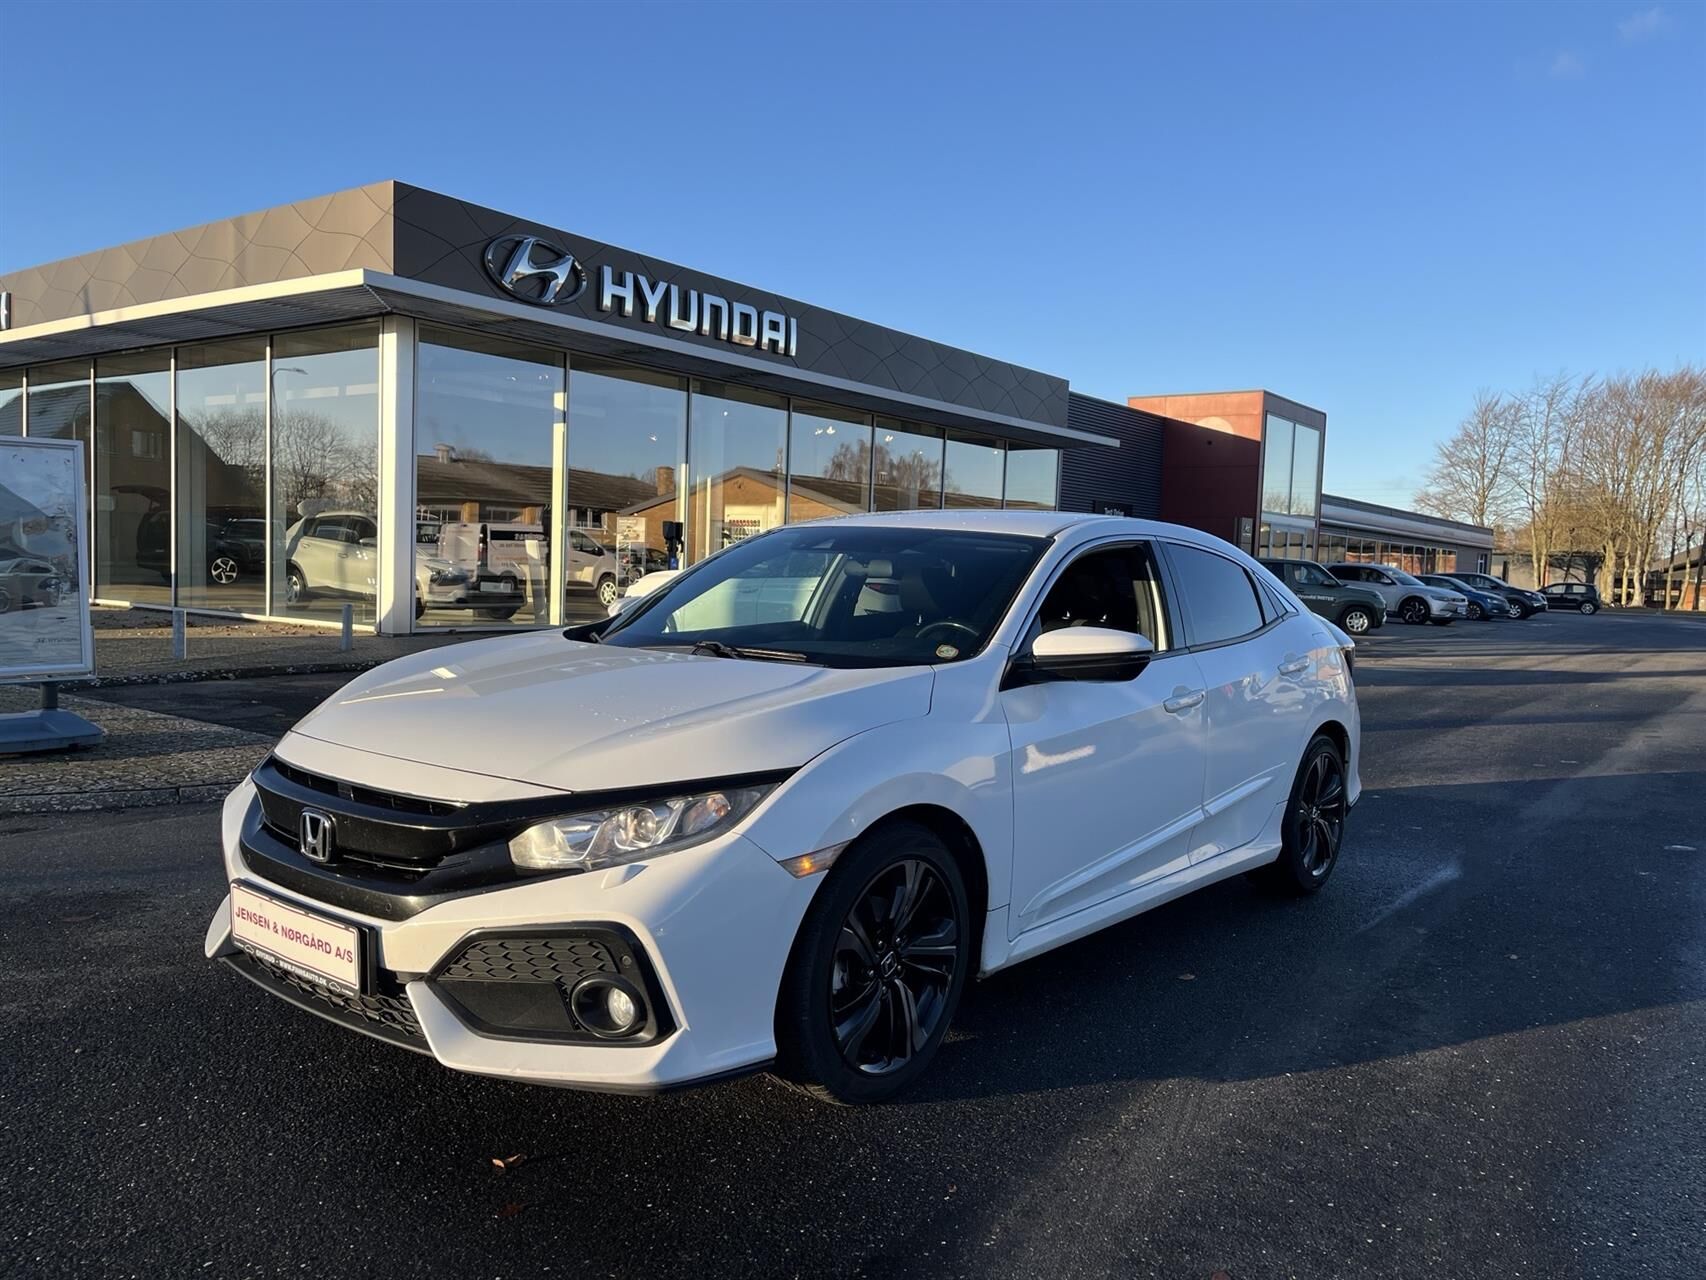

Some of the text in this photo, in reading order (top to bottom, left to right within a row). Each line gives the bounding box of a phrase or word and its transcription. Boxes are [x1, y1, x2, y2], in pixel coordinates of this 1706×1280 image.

[601, 264, 797, 357] HYUNDAI
[236, 907, 353, 963] JENSEN & NØRGÅRD A/S
